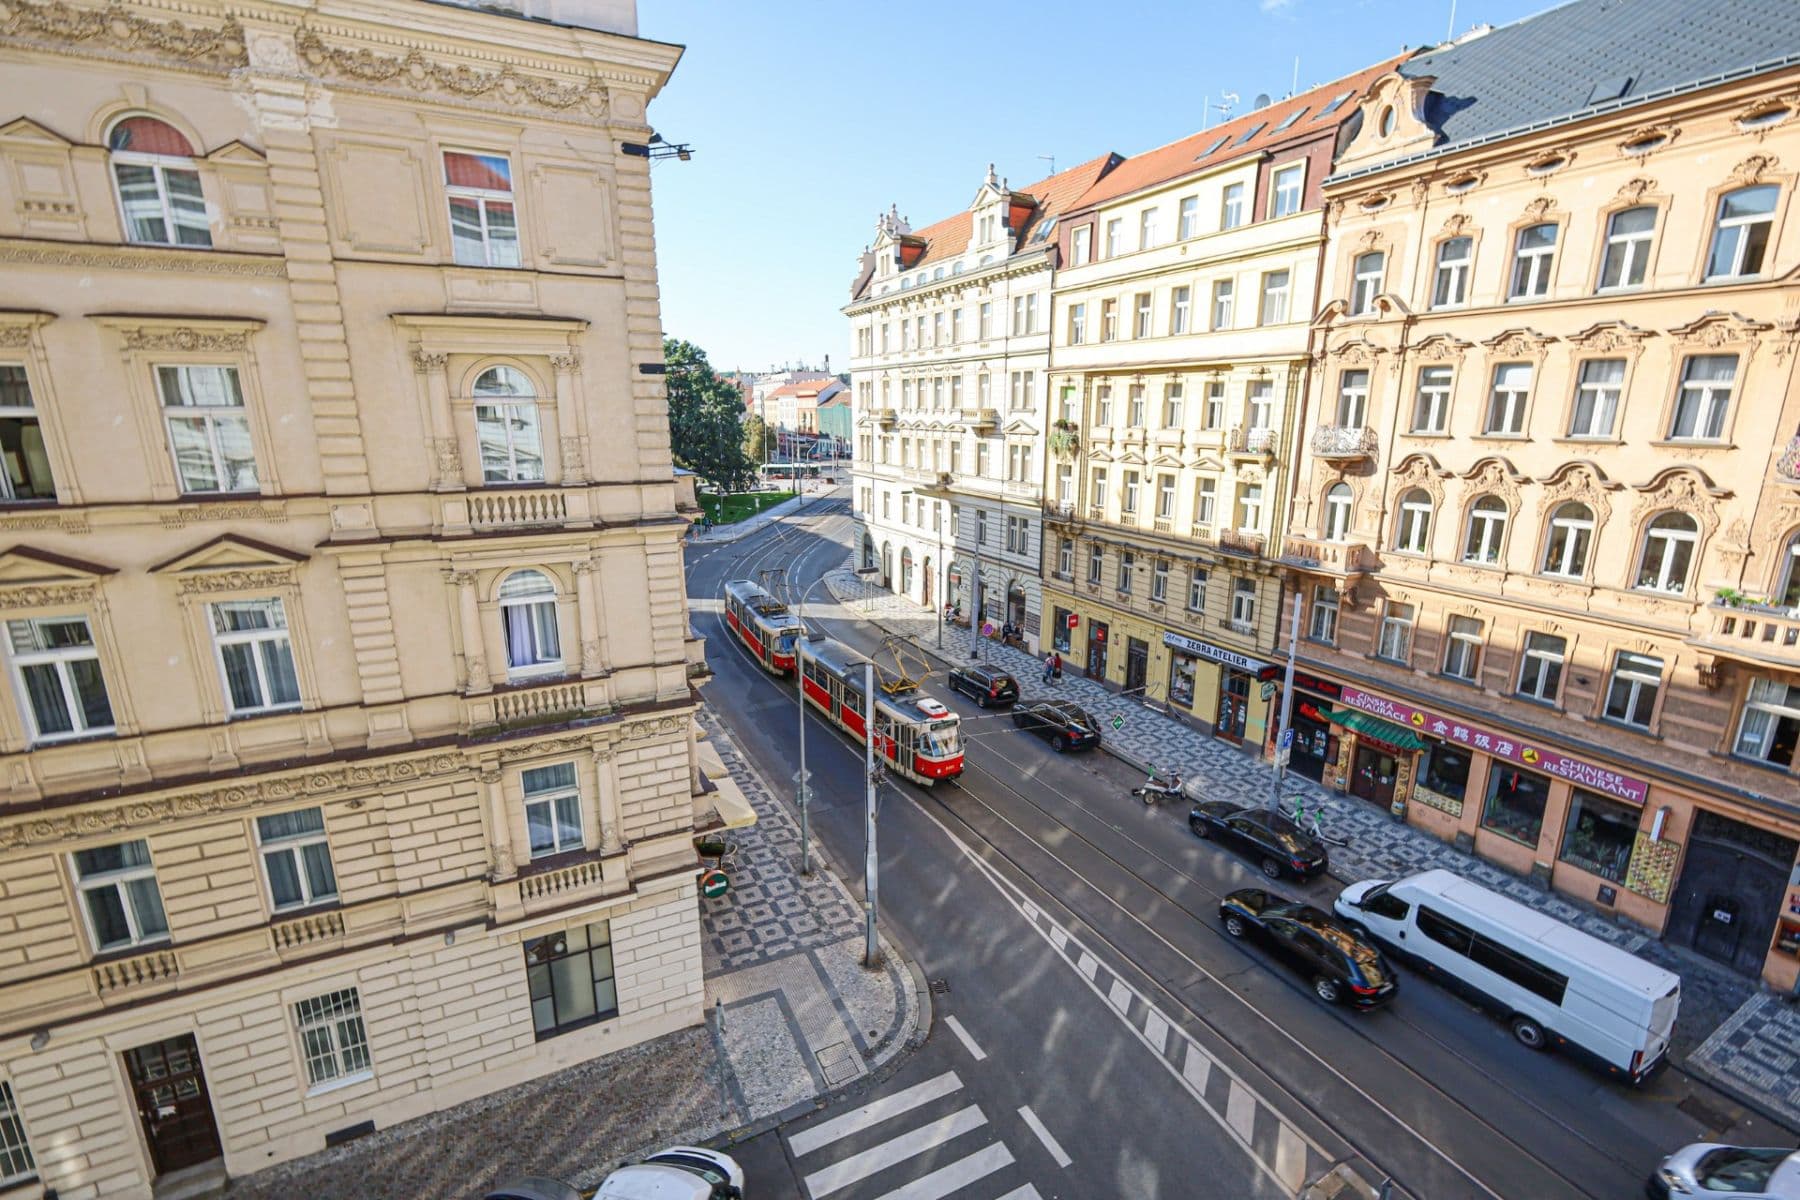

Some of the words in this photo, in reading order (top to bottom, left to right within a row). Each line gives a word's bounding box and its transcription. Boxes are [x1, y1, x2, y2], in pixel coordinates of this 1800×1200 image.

[1186, 640, 1212, 655] ZEBRA
[1213, 648, 1248, 667] ATELIER
[1344, 695, 1406, 722] RESTAURACE
[1543, 761, 1640, 800] RESTAURANT
[1560, 758, 1624, 786] CHINESE
